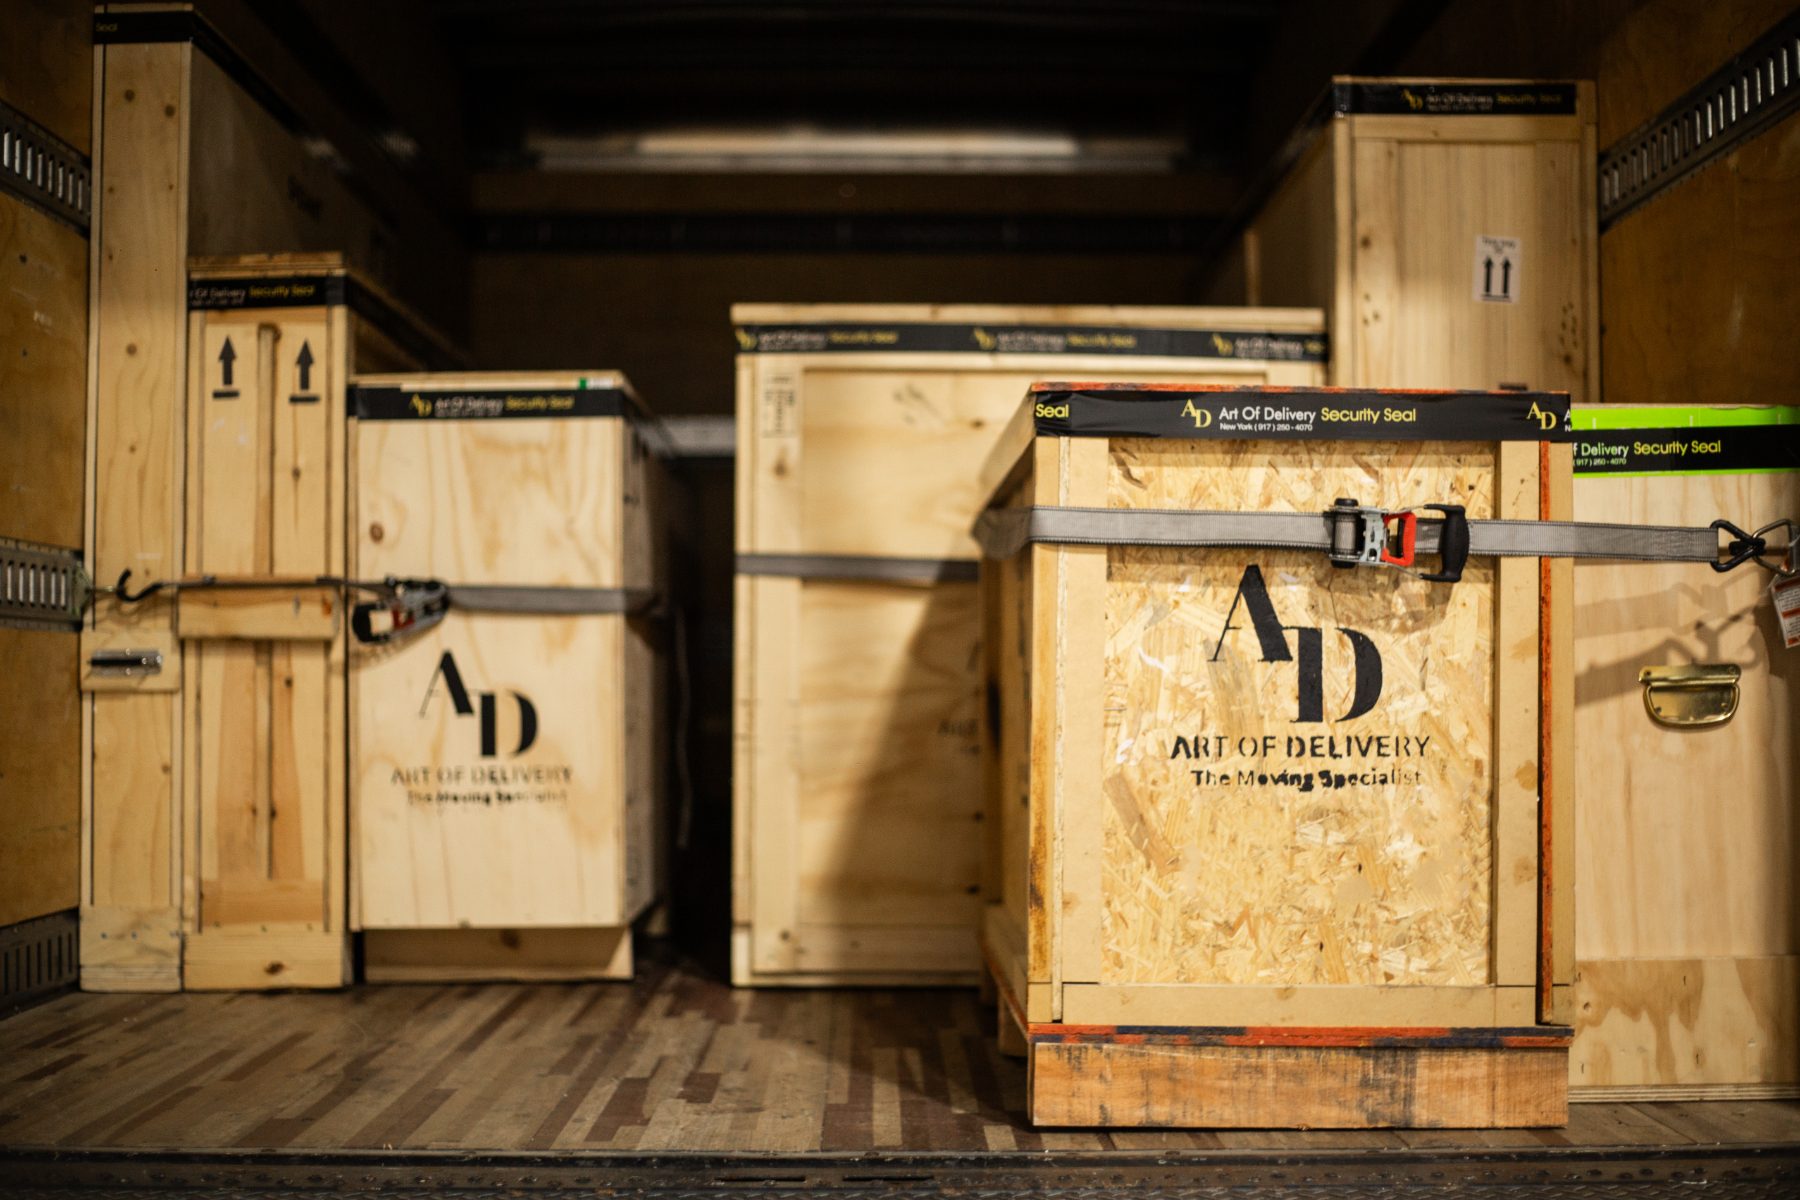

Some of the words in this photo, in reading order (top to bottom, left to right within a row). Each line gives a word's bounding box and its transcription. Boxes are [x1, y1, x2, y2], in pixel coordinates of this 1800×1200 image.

[1035, 403, 1069, 418] Seal
[1181, 399, 1212, 428] AD
[1219, 406, 1239, 421] Art
[1242, 406, 1261, 421] Of
[1264, 406, 1317, 424] Delivery
[1321, 407, 1380, 424] Security
[1384, 408, 1416, 422] Seal
[1526, 401, 1557, 430] AD
[1220, 423, 1236, 431] New
[1237, 423, 1253, 431] York
[1581, 442, 1630, 458] Delivery
[1634, 441, 1688, 456] Security
[1691, 440, 1721, 454] Seal
[1207, 564, 1383, 723] AD
[418, 650, 538, 758] AD
[1170, 735, 1229, 760] ART
[1238, 735, 1277, 759] OF
[1286, 735, 1431, 760] DELIVERY
[391, 765, 430, 785] ART
[437, 765, 463, 785] OF
[470, 765, 573, 785] DELIVERY
[1190, 769, 1231, 786] The
[1237, 770, 1314, 792] Moving
[1318, 767, 1422, 789] Specialist
